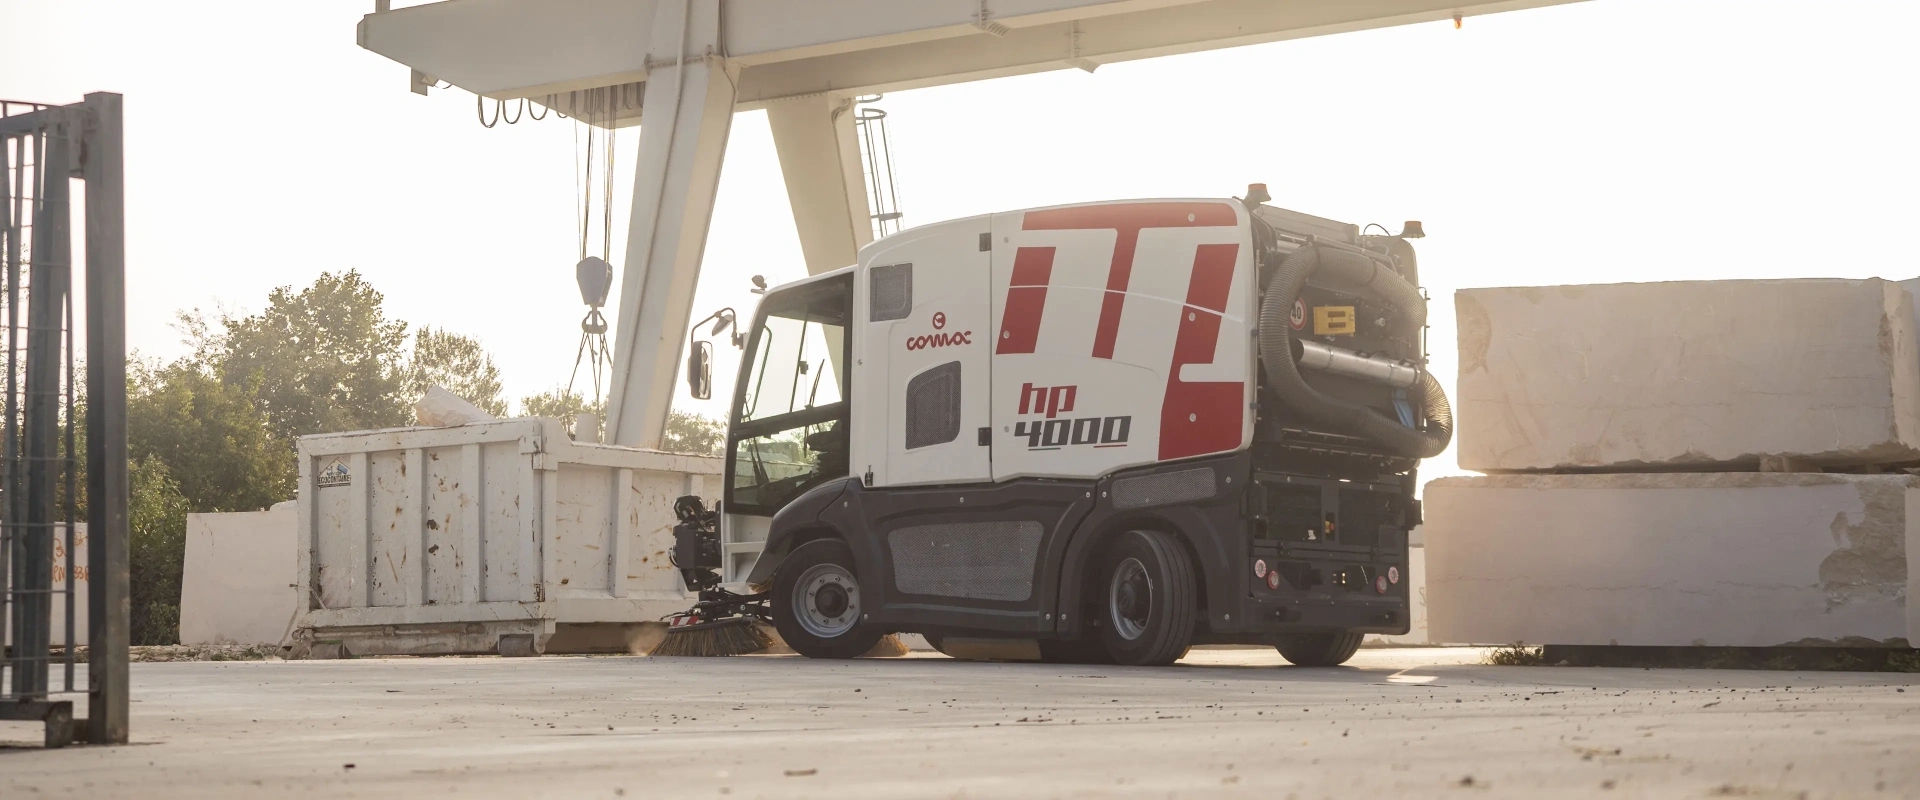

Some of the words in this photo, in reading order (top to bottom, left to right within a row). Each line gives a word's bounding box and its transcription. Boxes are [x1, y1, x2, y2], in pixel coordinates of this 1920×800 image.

[906, 330, 972, 351] comac
[1018, 382, 1077, 418] hp
[1014, 415, 1132, 447] 4000
